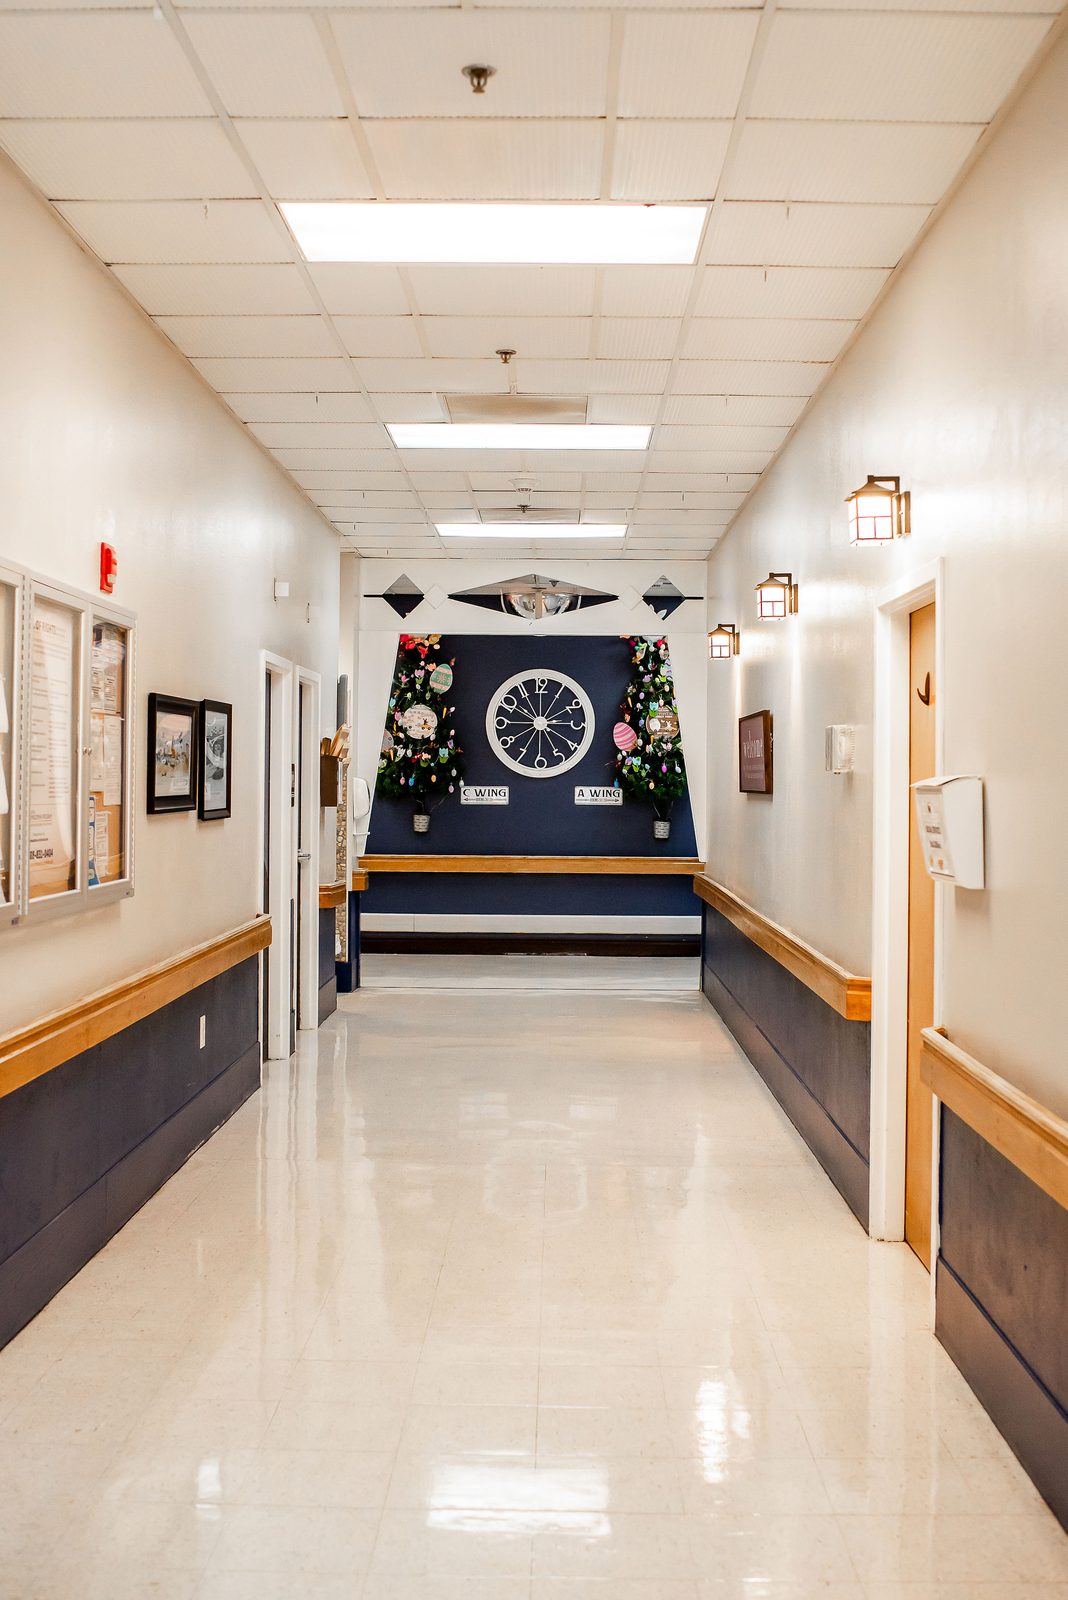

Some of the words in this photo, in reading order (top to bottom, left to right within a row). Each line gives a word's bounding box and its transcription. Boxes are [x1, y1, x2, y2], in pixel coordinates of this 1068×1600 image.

[516, 683, 530, 699] 11
[534, 678, 548, 693] 12
[554, 684, 566, 699] 1
[500, 694, 518, 713] 10
[565, 699, 582, 714] 2
[495, 716, 511, 729] 9
[570, 720, 587, 730] 3
[500, 736, 515, 748] 8
[567, 739, 581, 751] 4
[516, 748, 527, 763] 7
[534, 753, 547, 769] 6
[553, 749, 566, 763] 5
[463, 789, 470, 797] C
[474, 788, 507, 798] WING
[577, 789, 585, 798] A
[590, 789, 620, 798] WING
